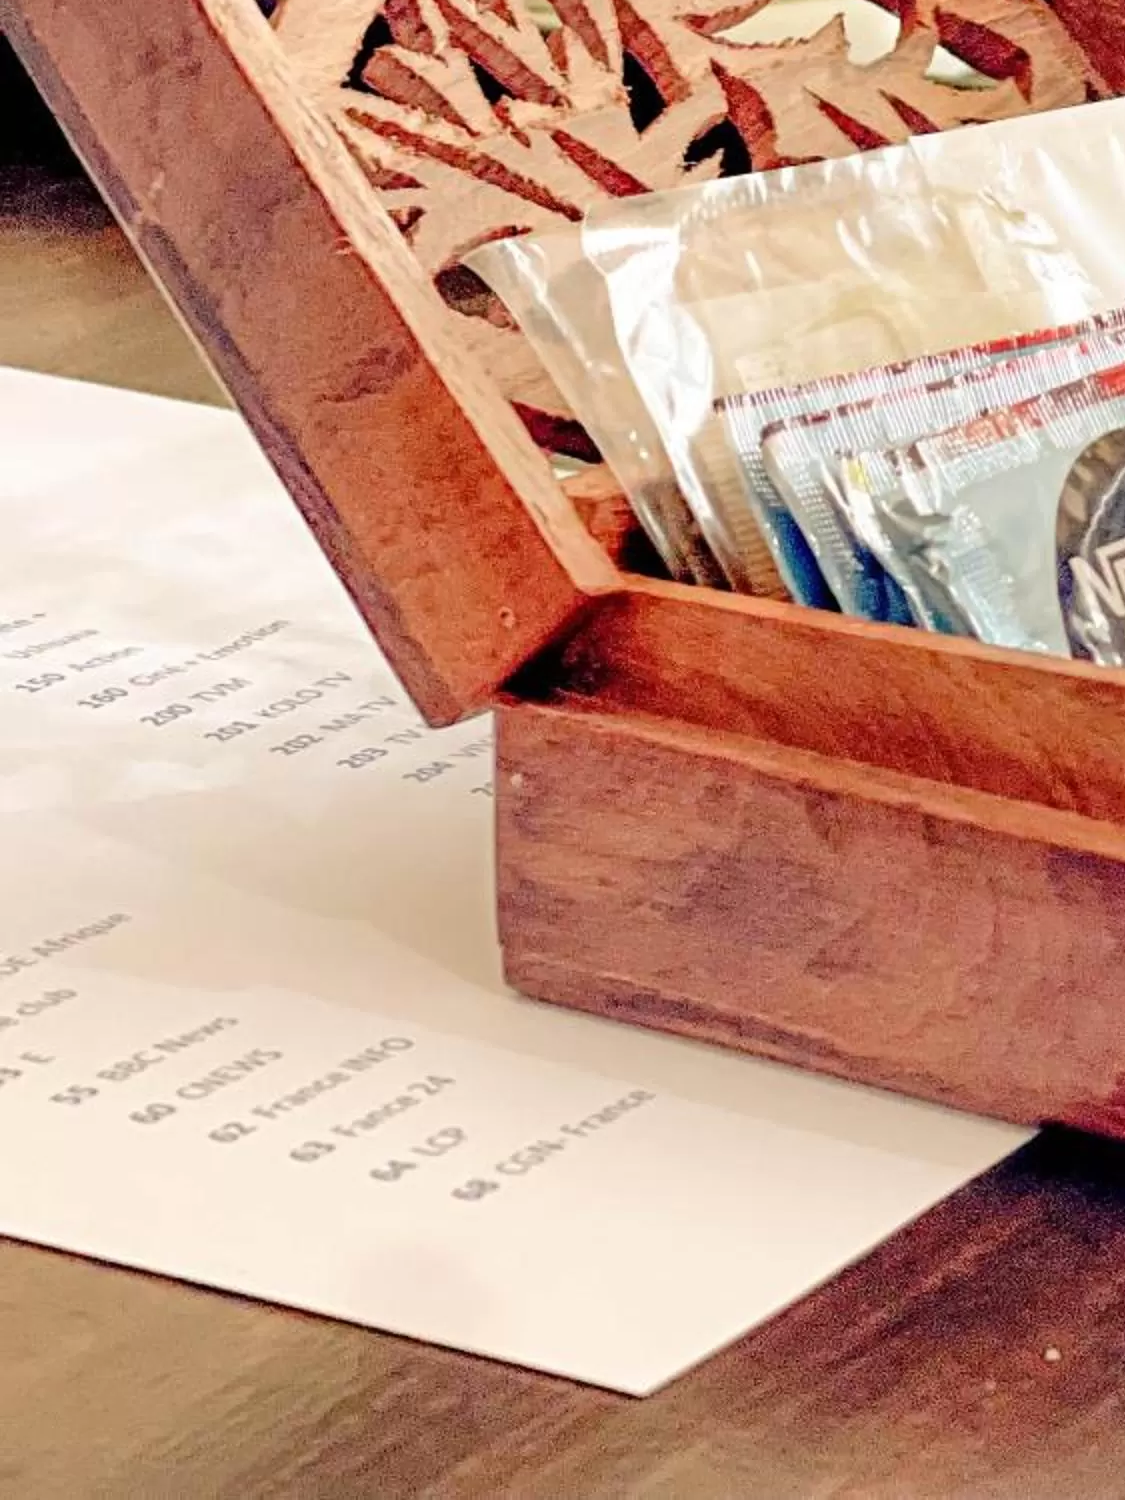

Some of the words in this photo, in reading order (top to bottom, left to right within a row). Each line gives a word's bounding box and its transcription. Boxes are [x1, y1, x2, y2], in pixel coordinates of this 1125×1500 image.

[15, 673, 67, 693] 150
[77, 687, 129, 709] 160
[140, 703, 193, 727] 200
[188, 676, 253, 702] TVM
[204, 720, 260, 742] 201
[252, 689, 324, 719] KOLO
[312, 671, 353, 688] TV
[269, 734, 325, 756] 202
[335, 747, 389, 768] 203
[402, 761, 456, 782] 204
[49, 1084, 100, 1105] 55
[96, 1050, 167, 1082] BBC
[152, 1016, 240, 1053] News
[129, 1102, 178, 1125] 60
[175, 1048, 284, 1100] CNEWS
[208, 1121, 258, 1143] 62
[250, 1071, 352, 1120] France
[289, 1140, 337, 1162] 63
[406, 1074, 456, 1096] 24
[369, 1160, 419, 1182] 64
[407, 1126, 468, 1157] LCP
